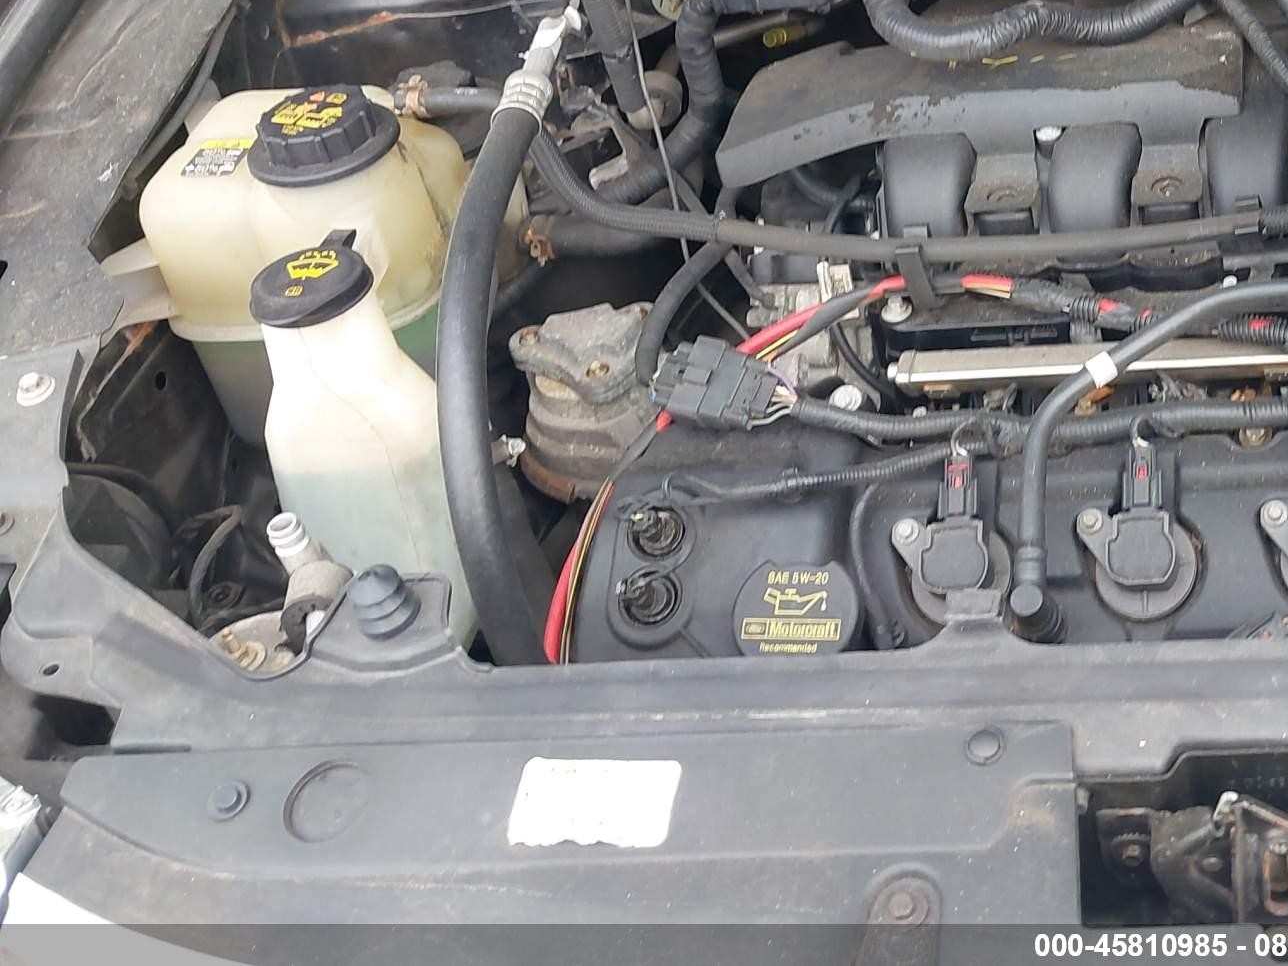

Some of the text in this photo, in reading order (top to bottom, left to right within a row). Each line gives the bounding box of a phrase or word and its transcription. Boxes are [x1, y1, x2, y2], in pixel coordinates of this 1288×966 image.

[767, 571, 830, 586] SAE 5W-20
[767, 621, 838, 639] Motorcraft
[759, 642, 818, 654] Recommended
